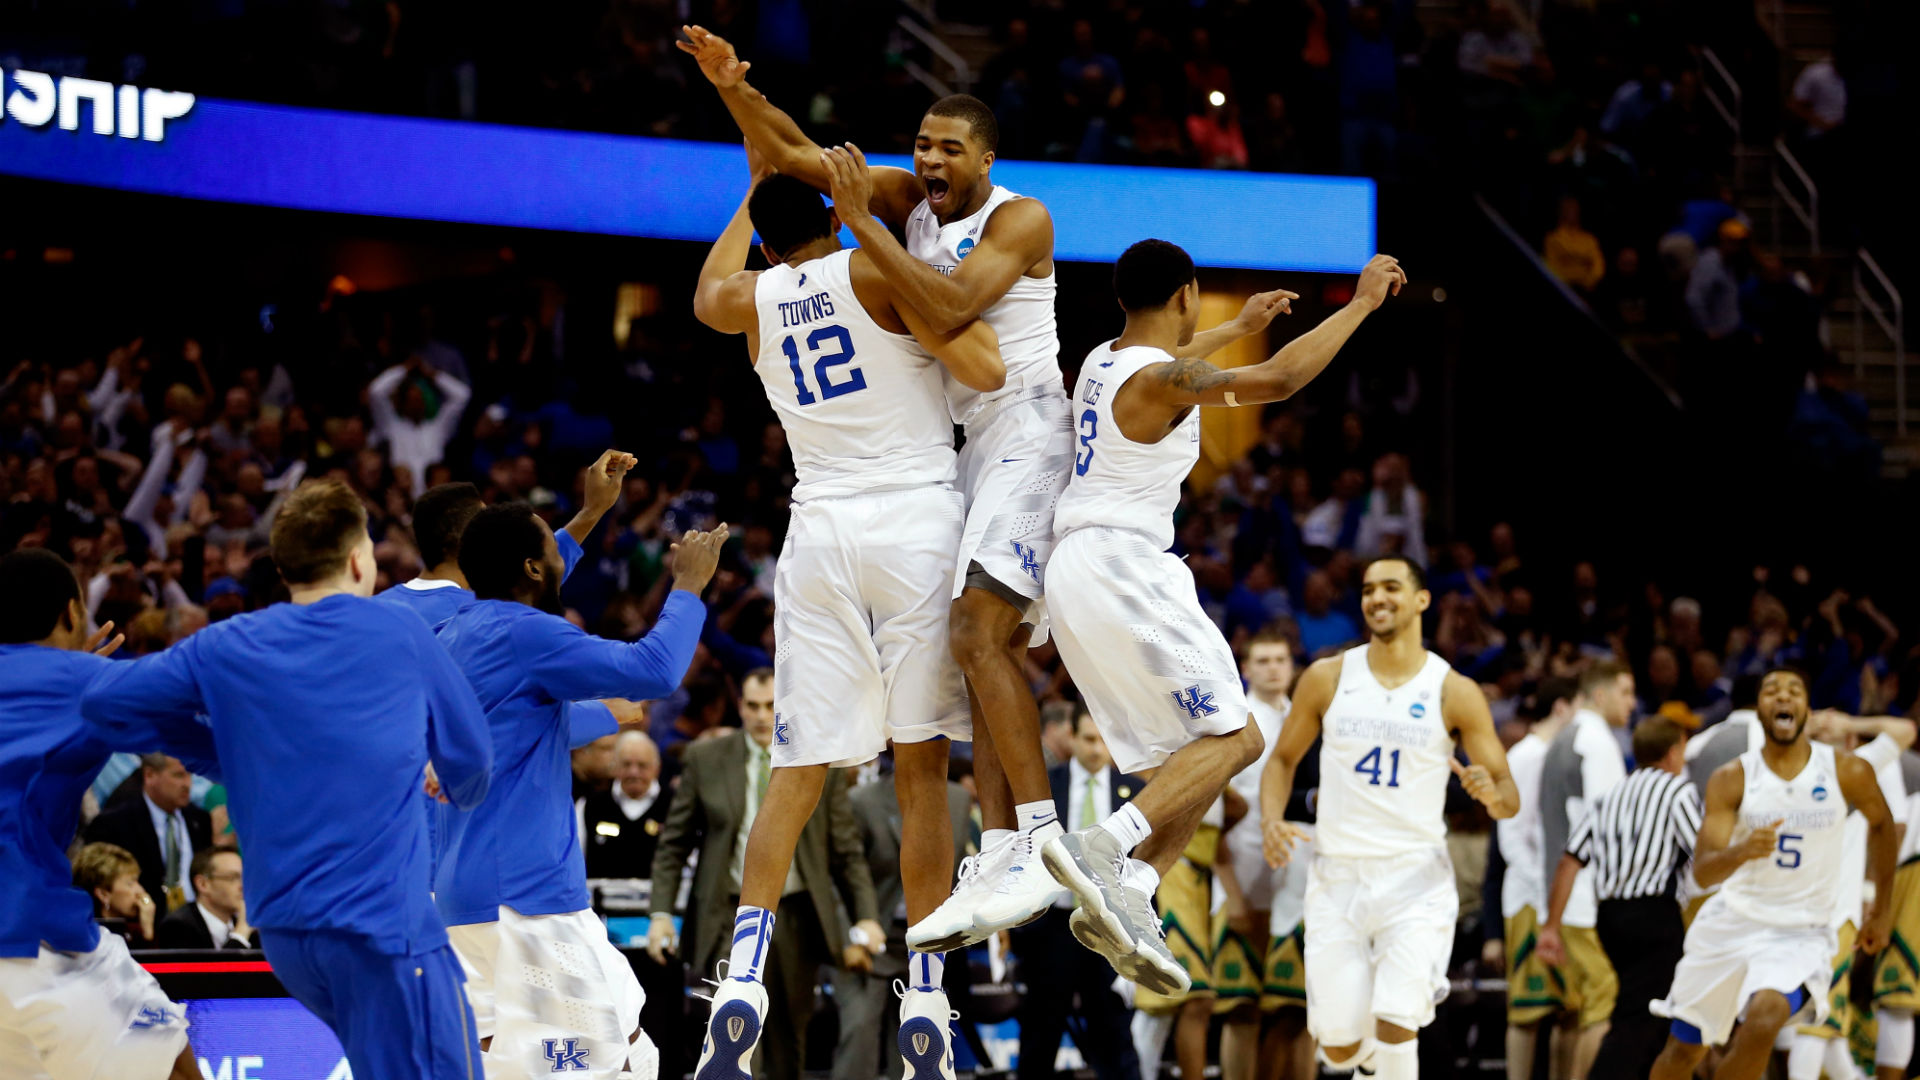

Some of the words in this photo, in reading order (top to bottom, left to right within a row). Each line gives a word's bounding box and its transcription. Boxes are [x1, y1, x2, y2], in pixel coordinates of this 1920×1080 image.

[0, 67, 196, 142] SHIP
[778, 292, 835, 328] TOWNS
[781, 324, 868, 406] 12
[1076, 409, 1098, 477] 3
[1171, 684, 1220, 719] UK
[1354, 746, 1401, 788] 41
[1776, 833, 1803, 869] 5
[542, 1038, 590, 1073] UK
